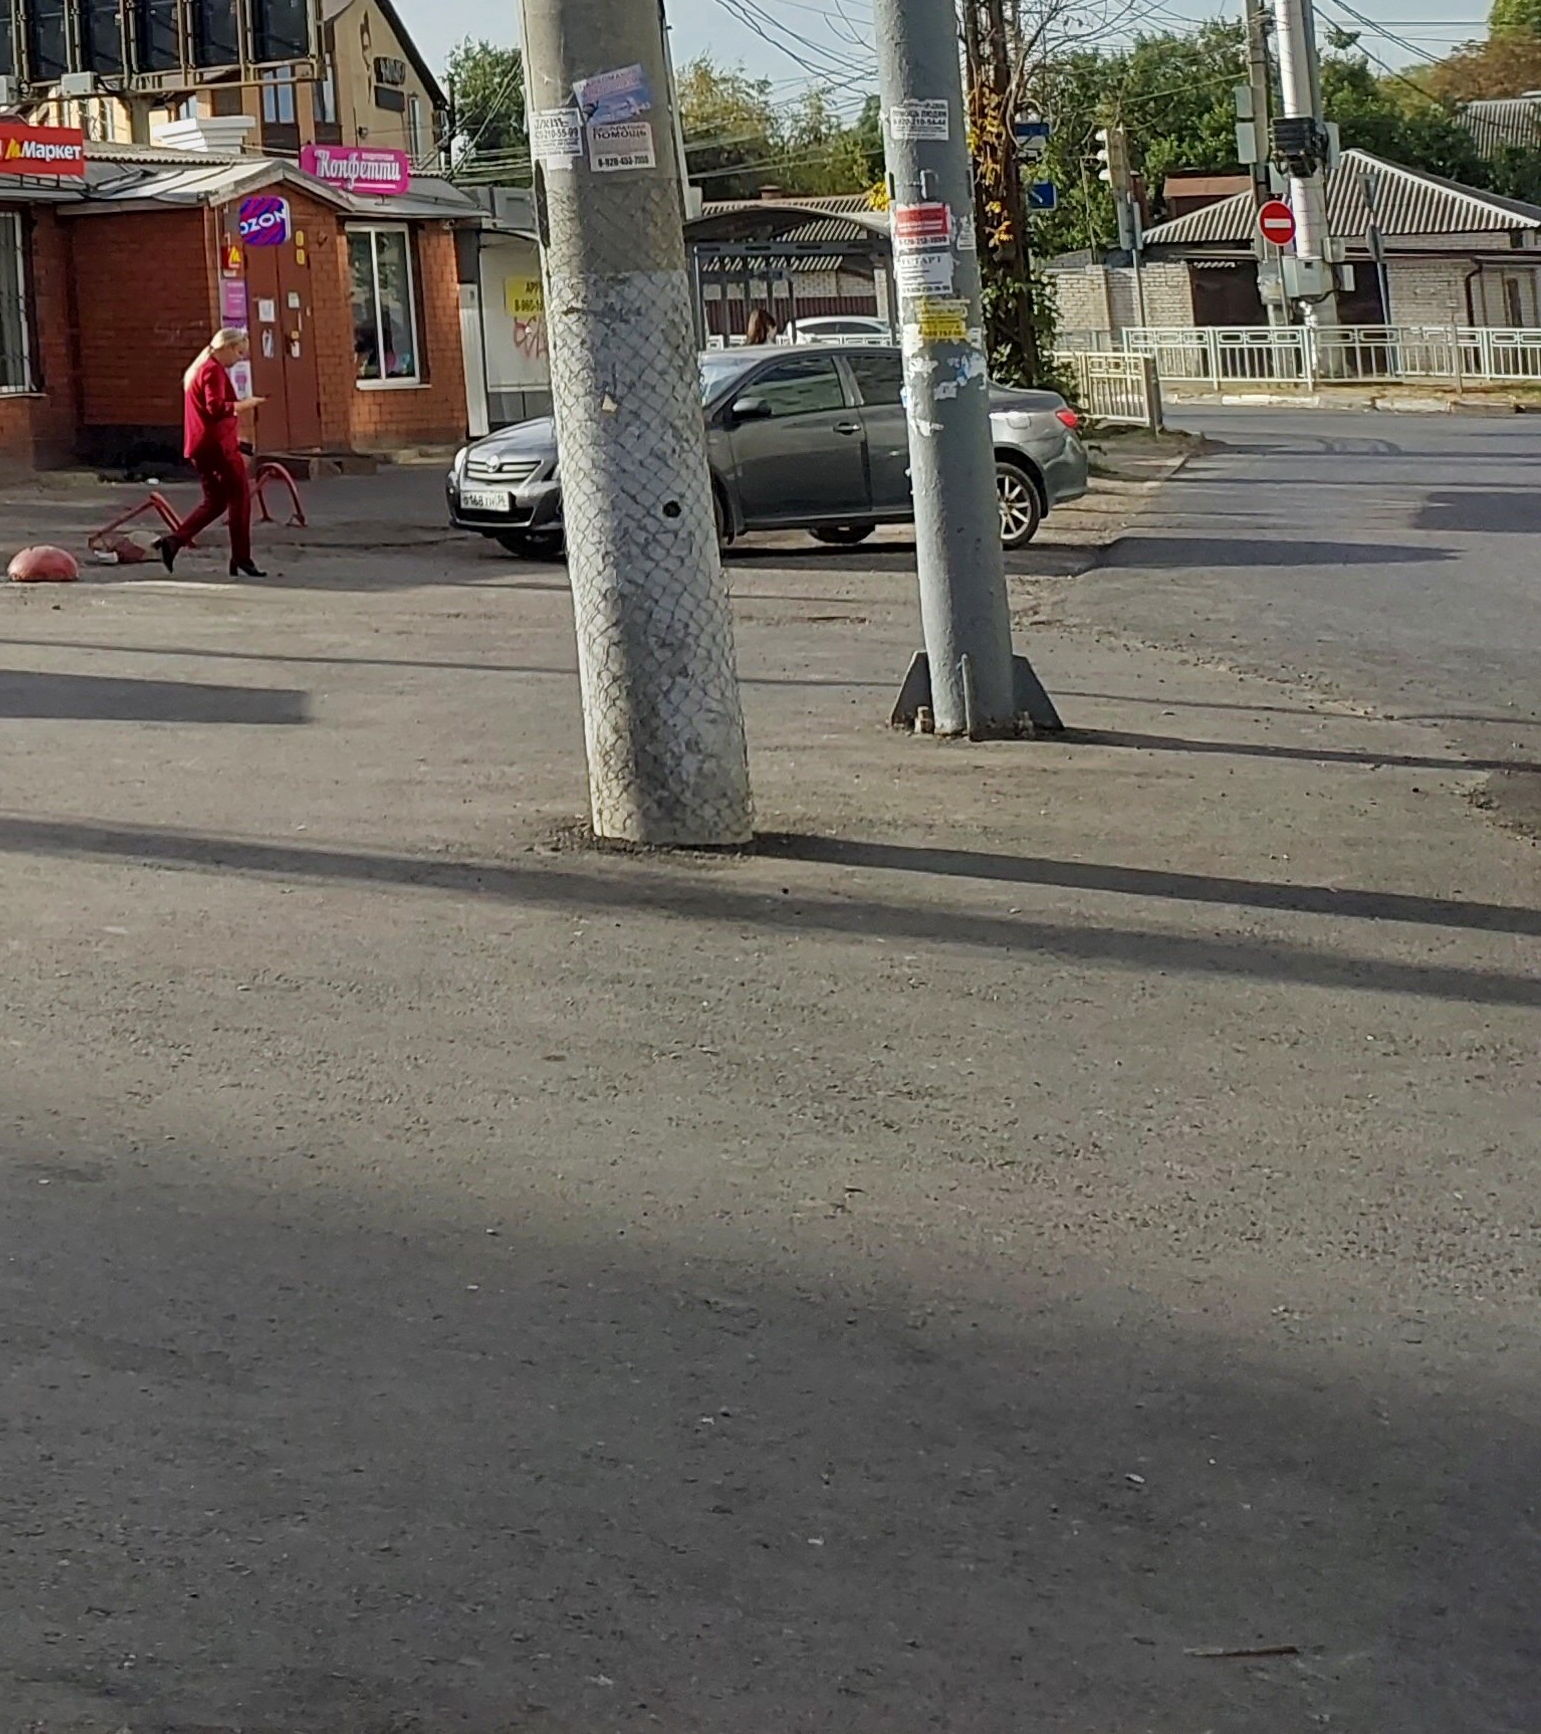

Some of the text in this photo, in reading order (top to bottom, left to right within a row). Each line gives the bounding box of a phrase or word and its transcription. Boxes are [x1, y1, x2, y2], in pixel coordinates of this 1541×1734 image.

[21, 141, 83, 163] Маркет
[314, 149, 402, 190] Конфетти
[240, 209, 286, 235] OZON
